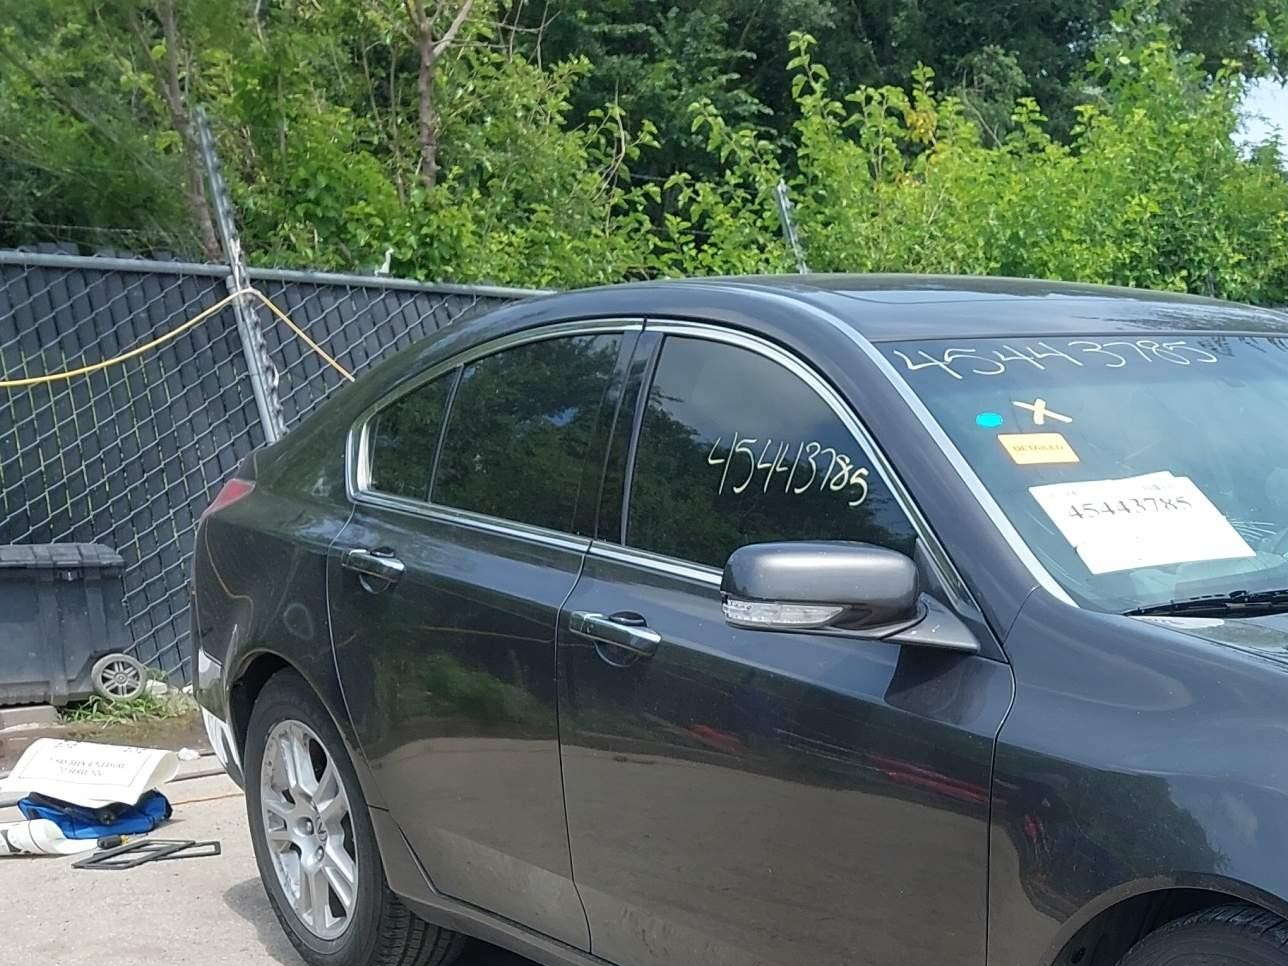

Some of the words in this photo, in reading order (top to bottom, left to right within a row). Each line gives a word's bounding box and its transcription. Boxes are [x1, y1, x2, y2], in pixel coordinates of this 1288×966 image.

[894, 340, 1218, 379] 45443785
[707, 432, 870, 507] 45443785
[1068, 496, 1193, 519] 45443785
